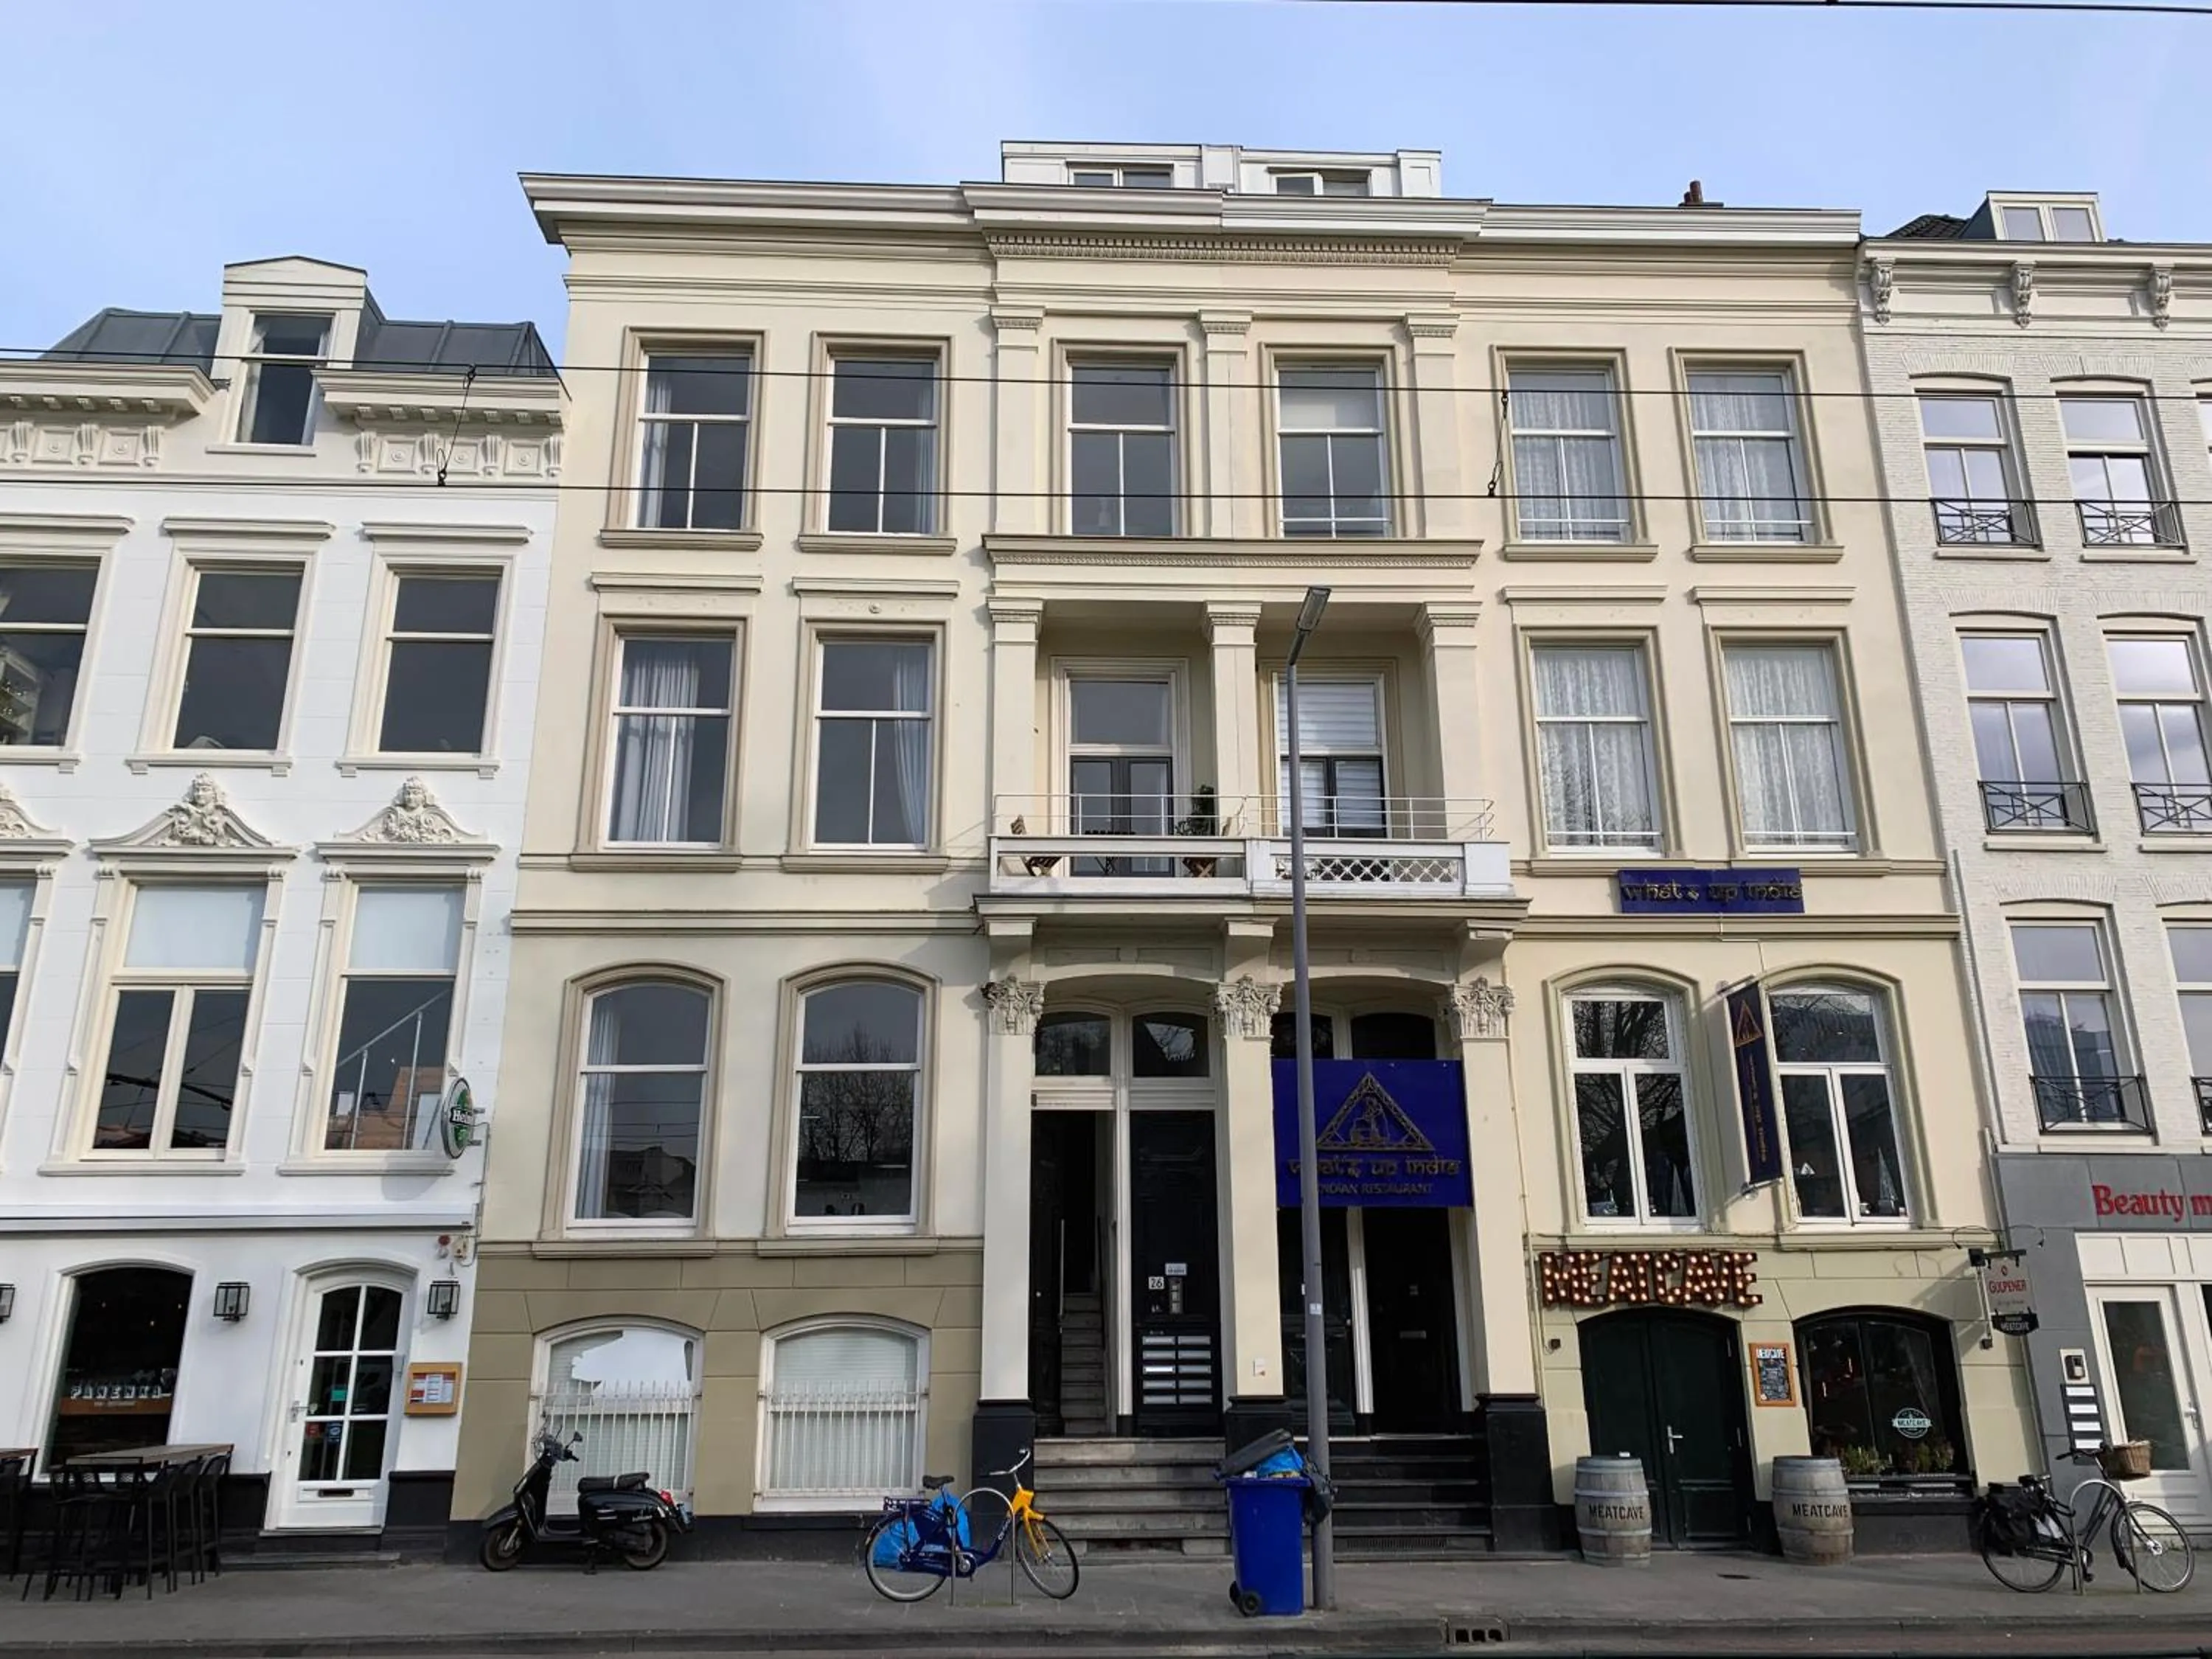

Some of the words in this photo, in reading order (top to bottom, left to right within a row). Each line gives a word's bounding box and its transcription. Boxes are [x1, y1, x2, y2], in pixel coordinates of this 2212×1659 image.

[1362, 1183, 1433, 1195] RESTAURANT
[2092, 1185, 2183, 1222] Beauty
[1151, 1277, 1163, 1288] 26
[1540, 1252, 1763, 1307] MEATCAVE
[1589, 1503, 1644, 1520] MEATCAVE
[1792, 1503, 1848, 1518] MEATCAVE
